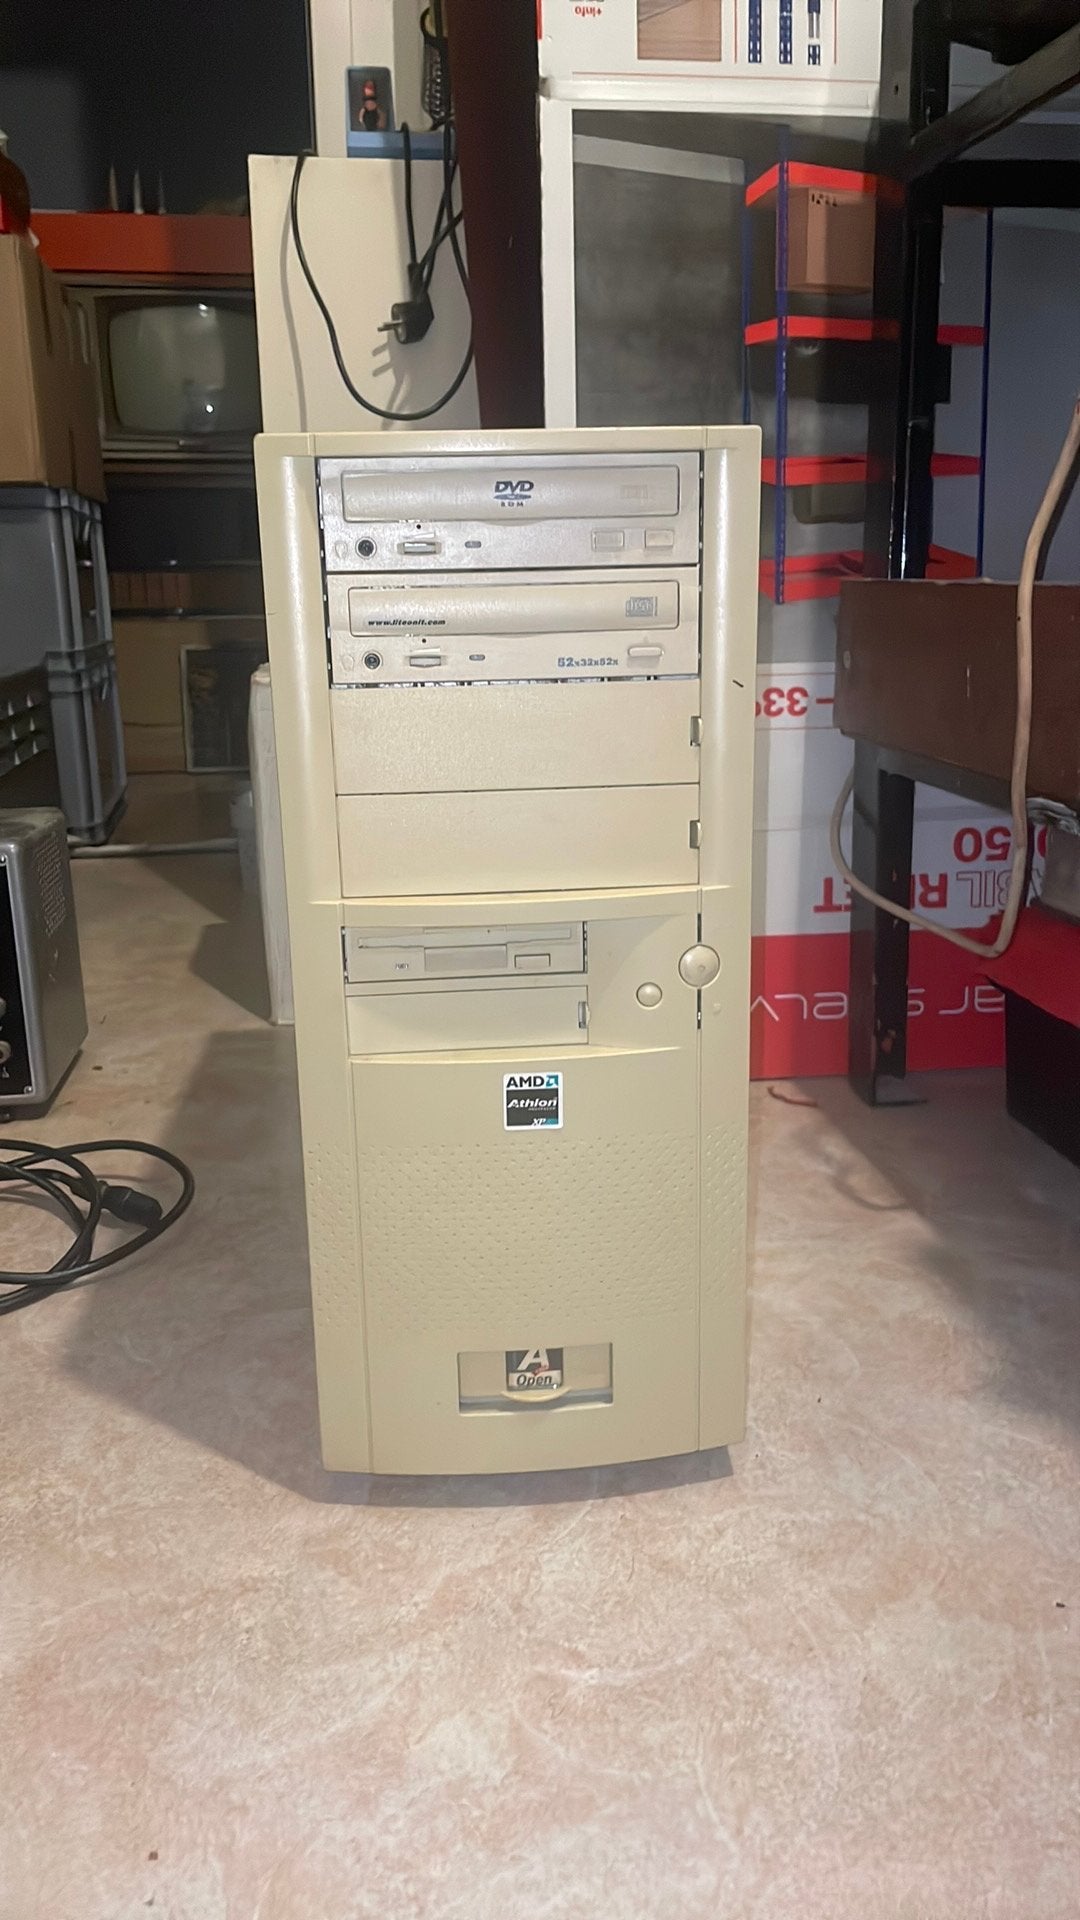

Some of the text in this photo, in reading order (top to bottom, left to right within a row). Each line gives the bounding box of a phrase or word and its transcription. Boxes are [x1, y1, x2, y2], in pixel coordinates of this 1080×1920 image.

[494, 481, 534, 495] DVD
[755, 686, 809, 718] 33
[506, 1076, 545, 1088] AMD
[507, 1097, 557, 1108] Athlon
[531, 1117, 547, 1126] XP
[517, 1347, 549, 1371] A
[517, 1374, 553, 1386] Open
